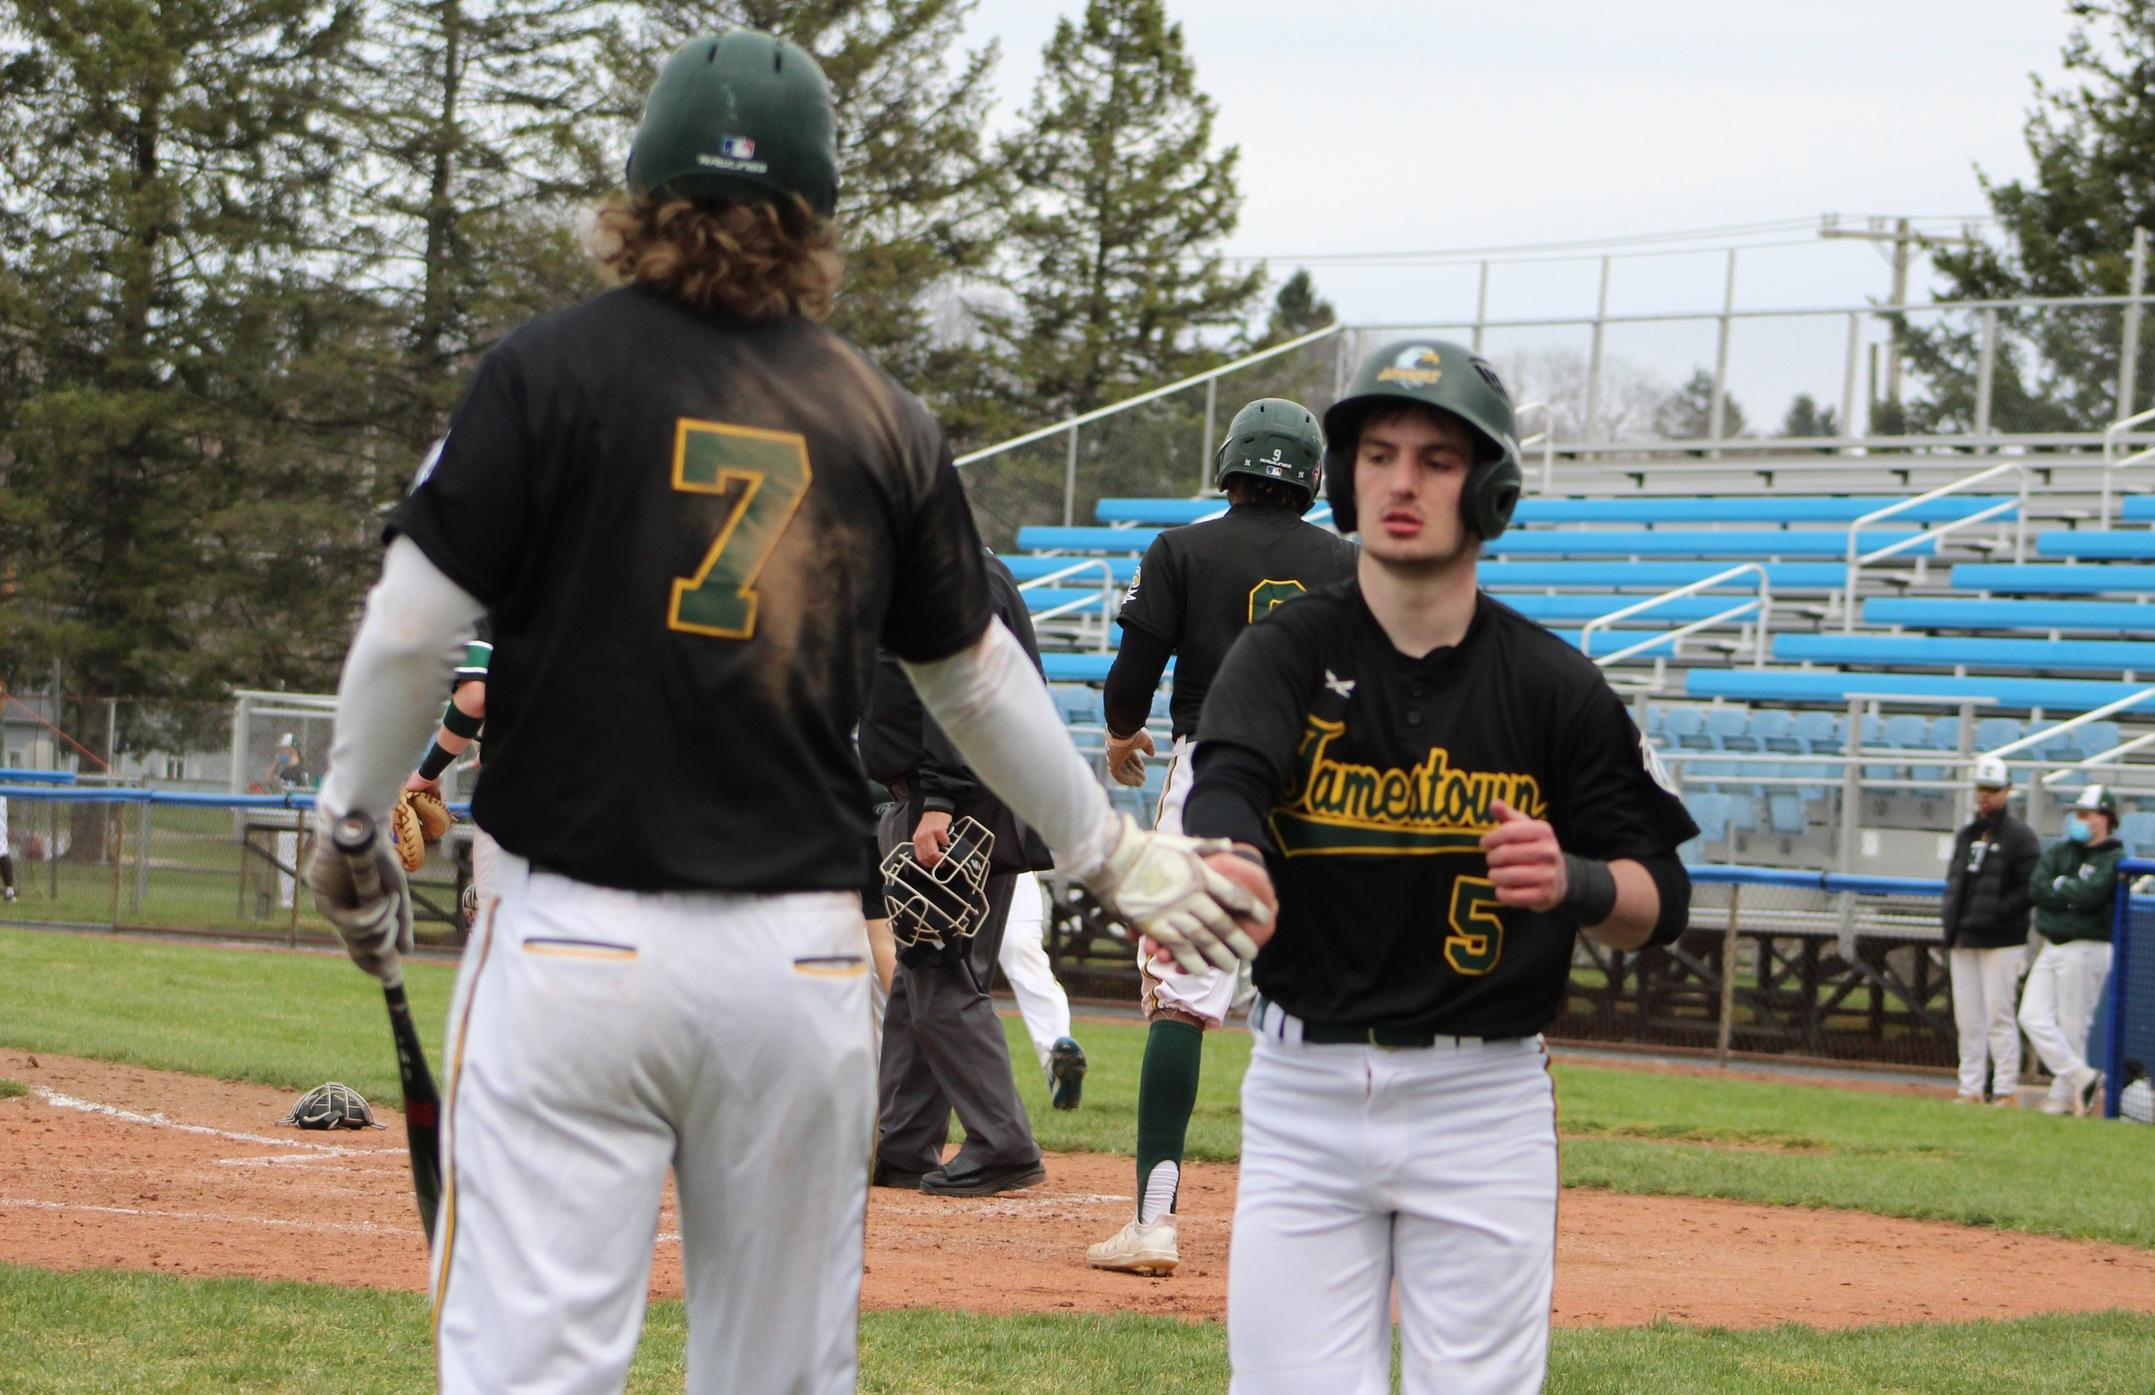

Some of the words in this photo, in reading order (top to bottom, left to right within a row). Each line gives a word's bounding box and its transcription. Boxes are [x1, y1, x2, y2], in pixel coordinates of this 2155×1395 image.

[1272, 448, 1282, 462] 9
[668, 416, 813, 640] 7
[1280, 713, 1547, 827] Jamestown
[1444, 875, 1505, 975] 5
